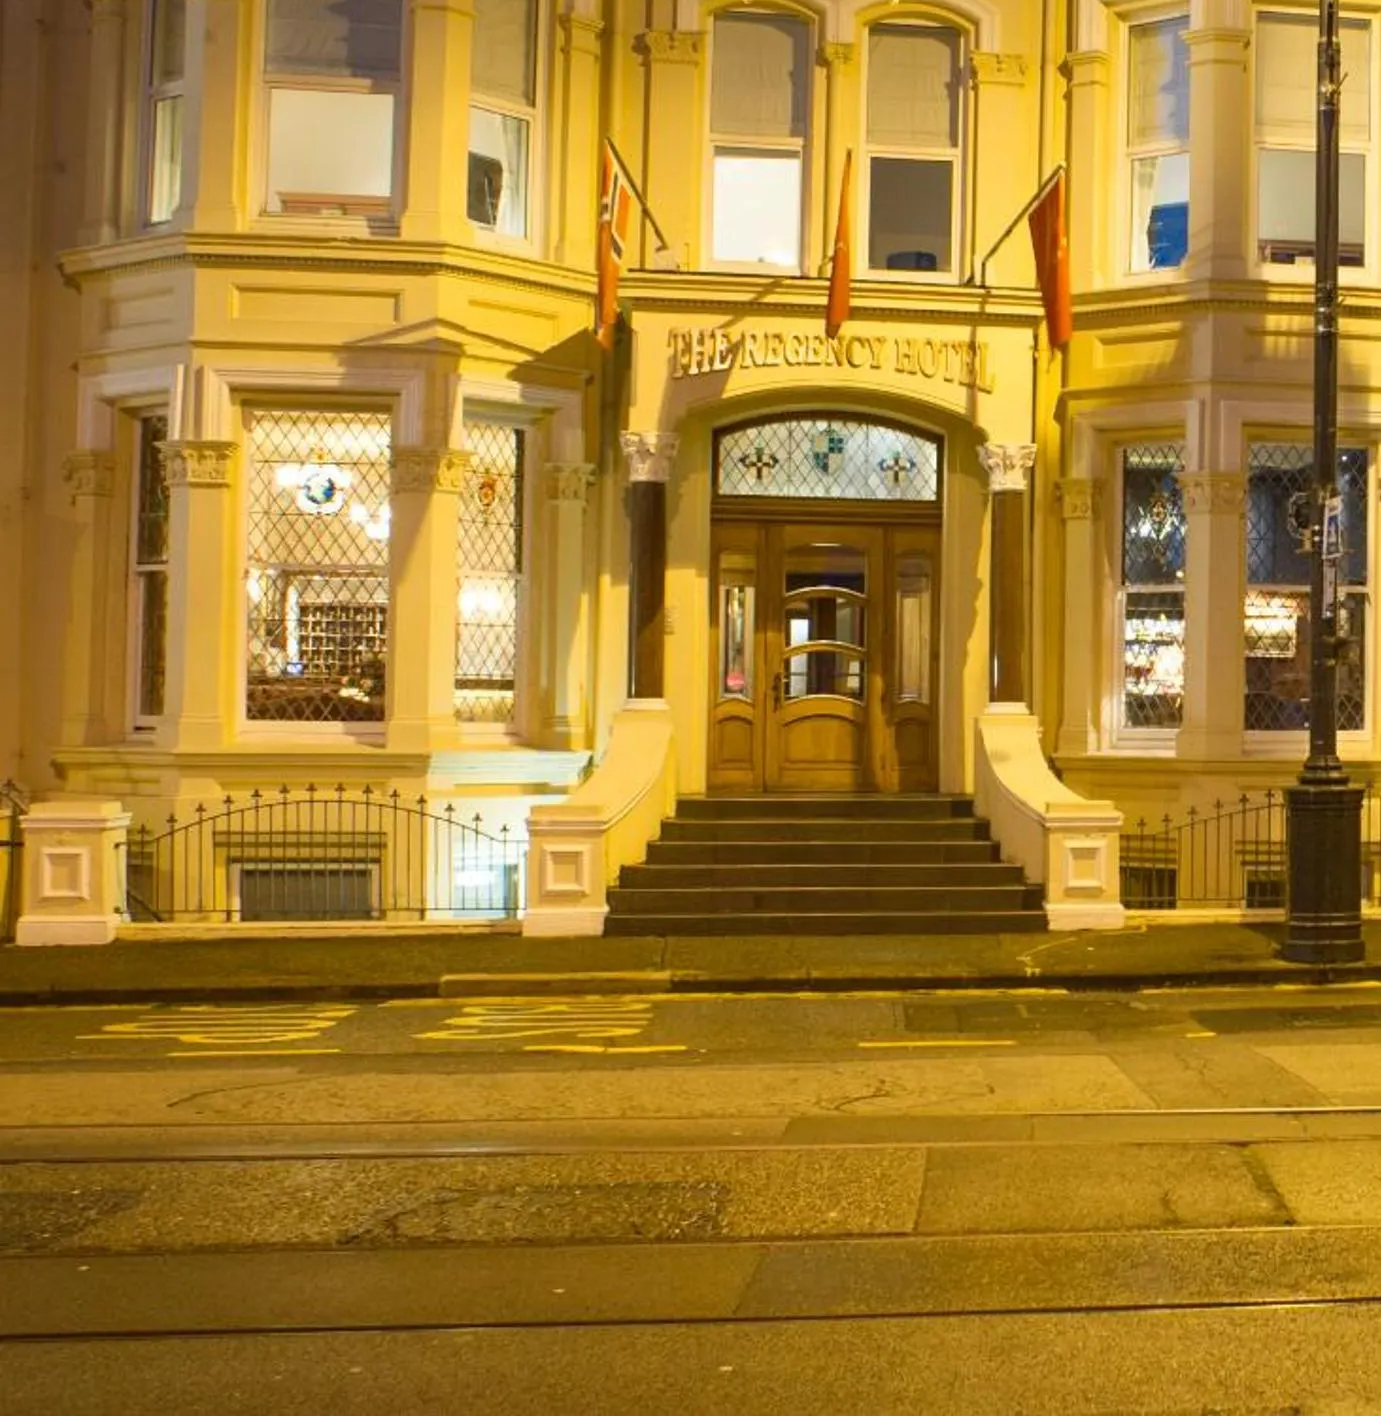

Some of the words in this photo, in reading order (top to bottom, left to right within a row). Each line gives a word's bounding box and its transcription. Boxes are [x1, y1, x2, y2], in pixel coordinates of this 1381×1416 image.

[667, 326, 733, 380] THE
[739, 327, 887, 371] REGENCY
[895, 337, 995, 394] HOTEL
[411, 1002, 654, 1039] BUS
